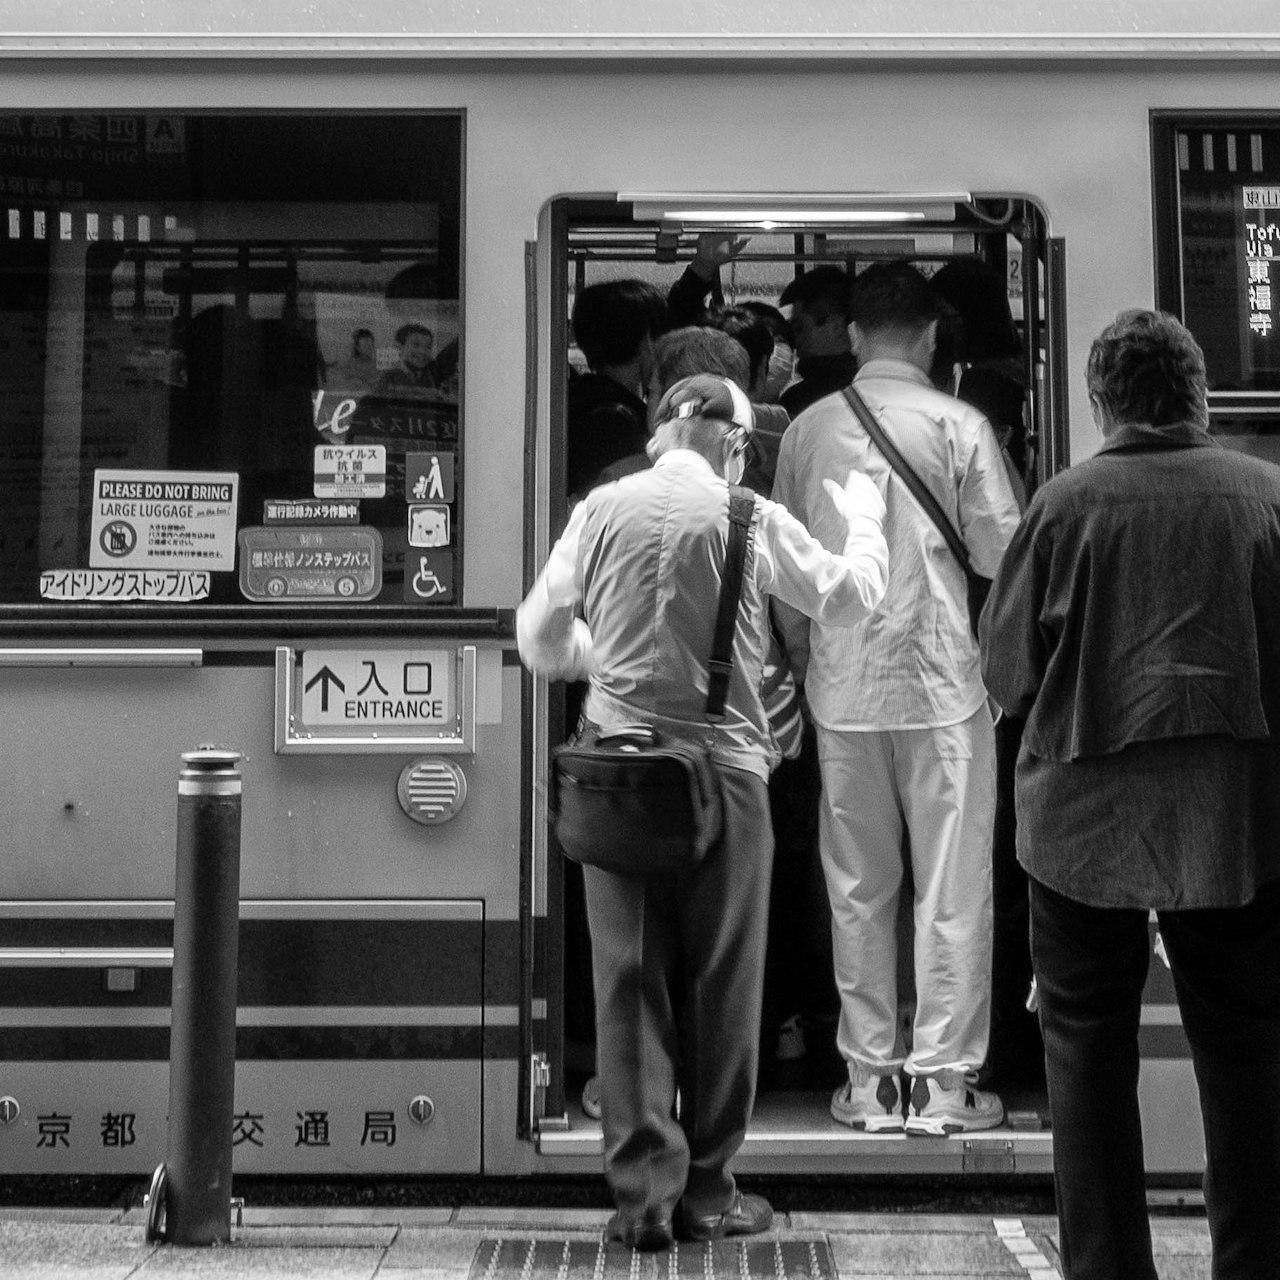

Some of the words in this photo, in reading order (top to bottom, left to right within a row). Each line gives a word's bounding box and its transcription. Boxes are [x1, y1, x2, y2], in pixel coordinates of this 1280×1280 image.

[322, 449, 378, 461] 抗ウイルス
[337, 460, 364, 473] 抗菌
[101, 482, 143, 499] PLEASE
[145, 483, 163, 499] DO
[164, 483, 191, 500] NOT
[191, 484, 230, 501] BRING
[100, 503, 137, 518] LARGE
[139, 504, 194, 519] LUGGAGE
[267, 504, 358, 520] 運行記録カメラ作動中
[251, 551, 371, 569] 標準仕様ノンステップバス
[41, 571, 209, 597] アイドリングストップバス
[356, 660, 433, 697] 入口
[344, 700, 444, 719] ENTRANCE
